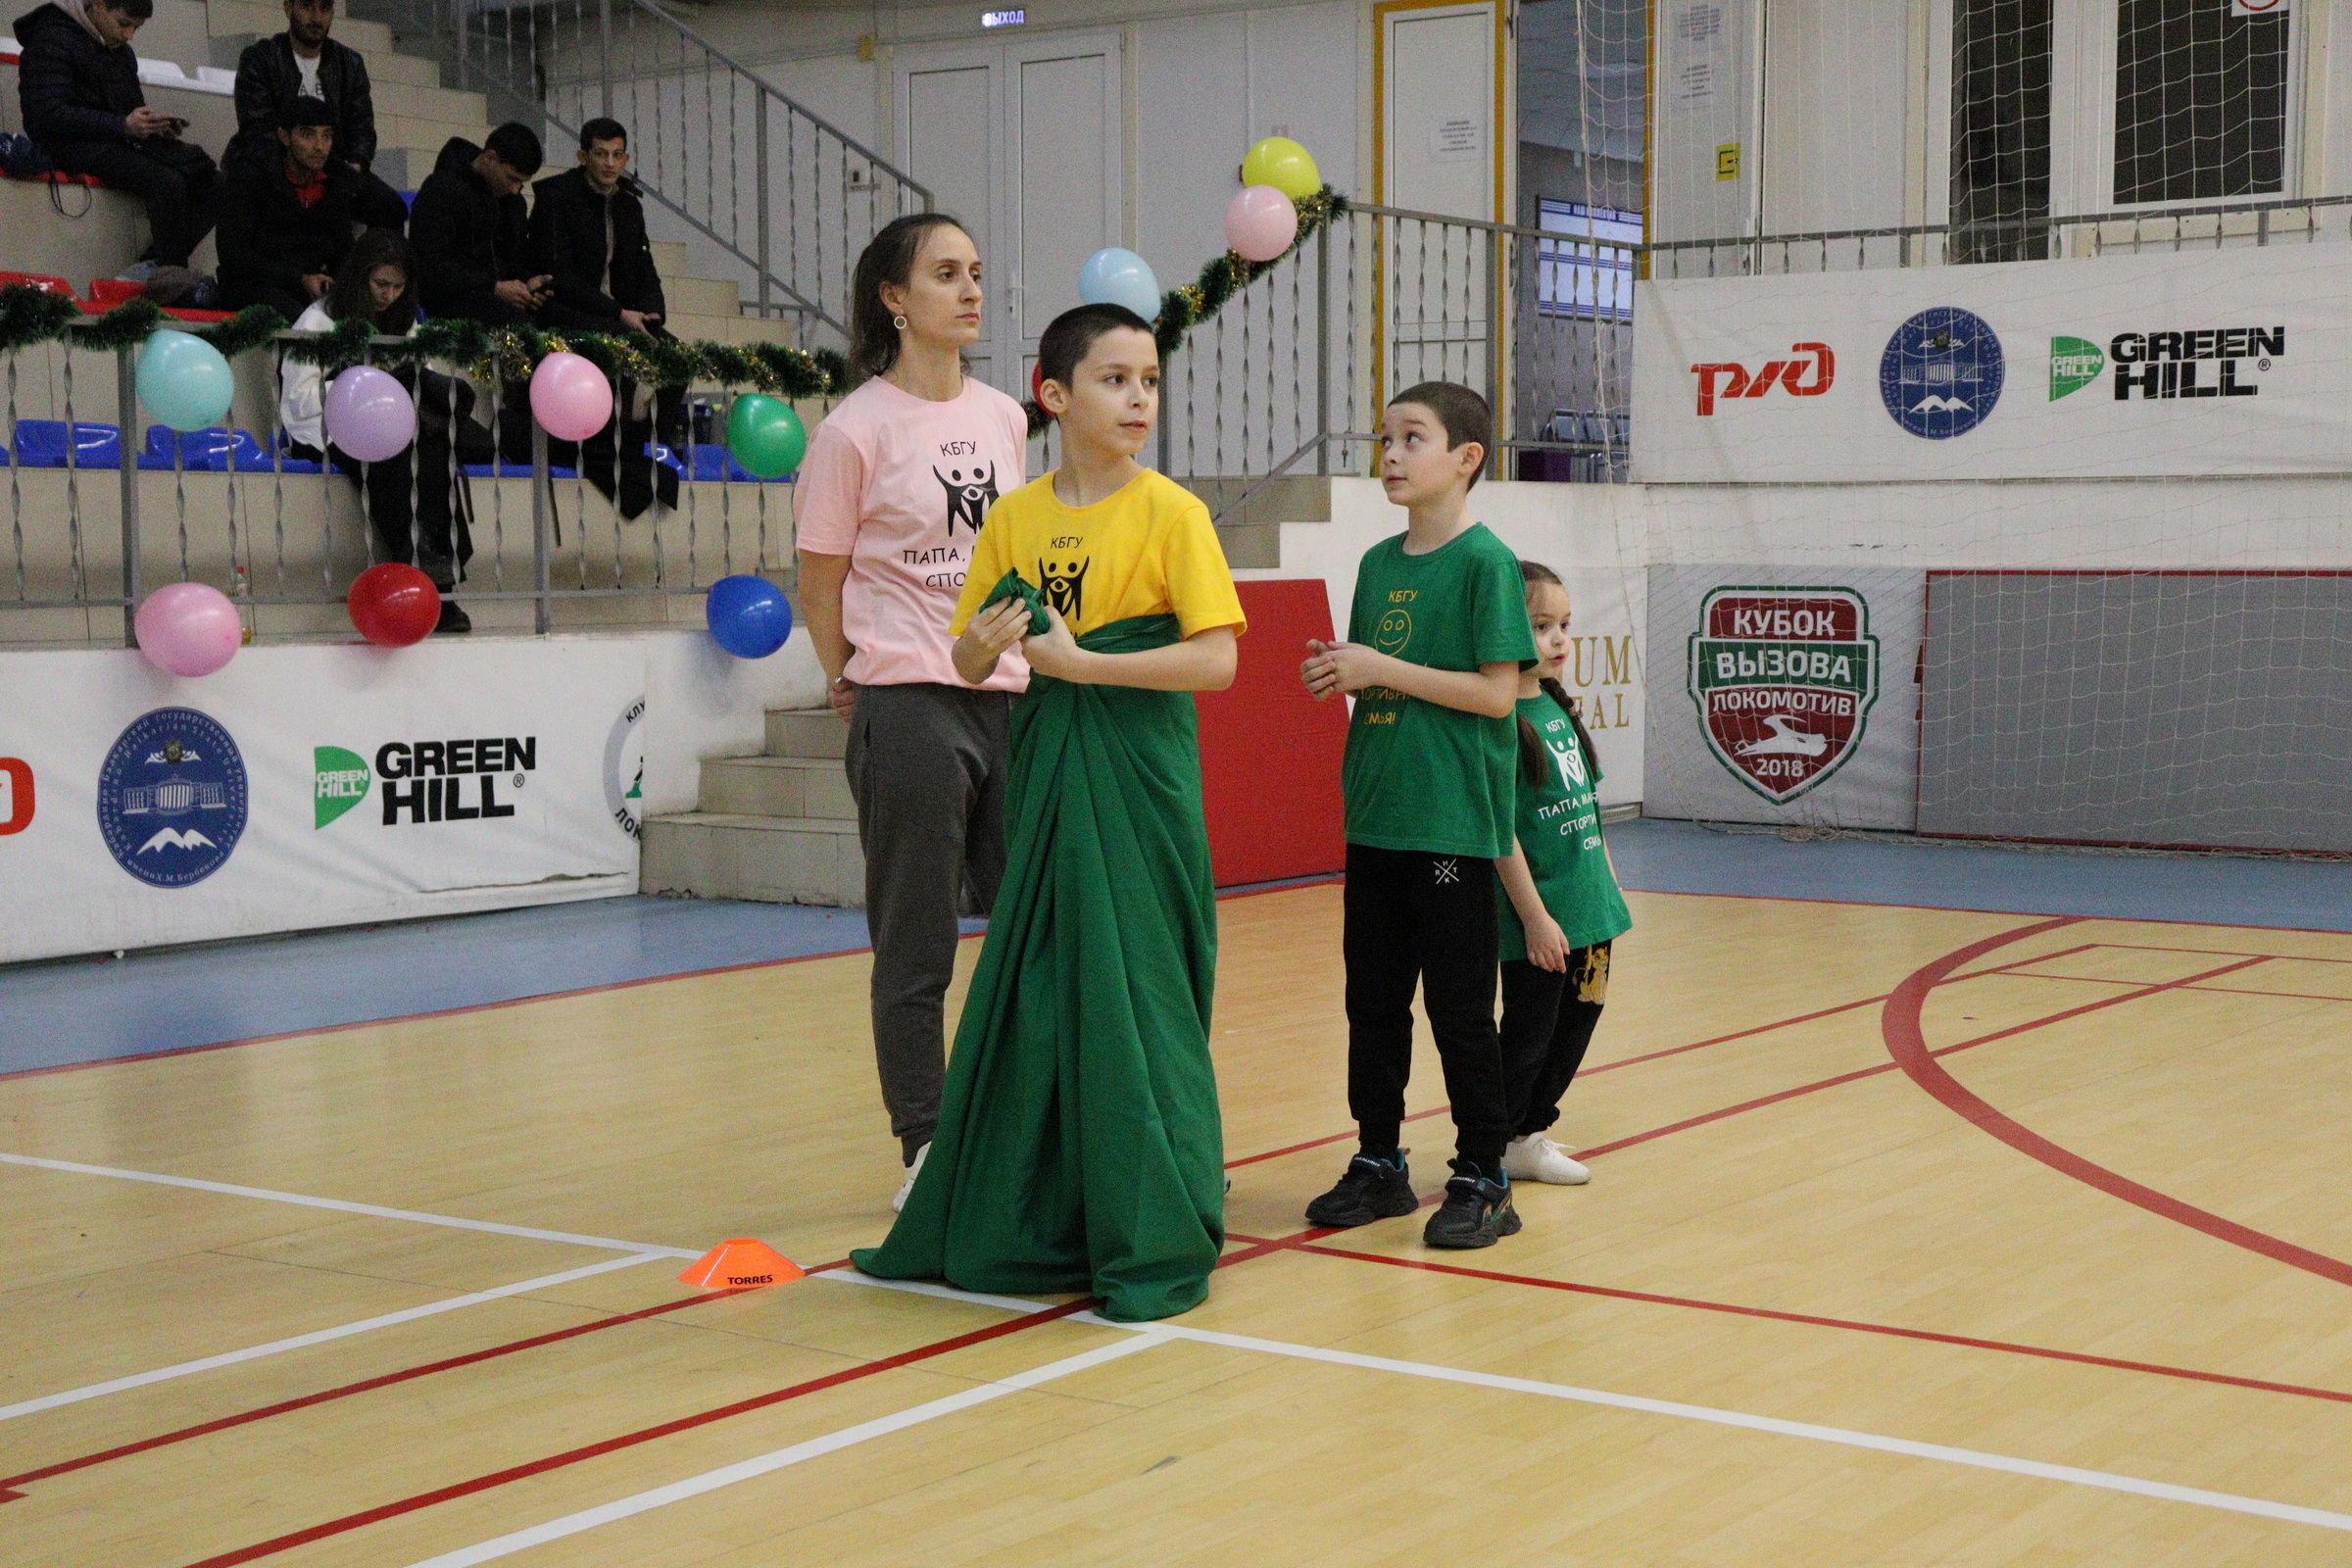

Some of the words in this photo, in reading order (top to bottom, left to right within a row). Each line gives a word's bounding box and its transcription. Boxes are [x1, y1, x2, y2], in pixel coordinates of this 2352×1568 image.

[982, 10, 1025, 27] ВЫХОД
[2111, 326, 2285, 363] GREEN
[2051, 354, 2103, 366] GREEN
[2053, 364, 2094, 377] HILL
[2115, 360, 2258, 400] HILL
[940, 441, 976, 457] КБГУ
[1051, 536, 1084, 549] КБГУ
[903, 548, 966, 564] ПАПА,
[1388, 590, 1418, 603] КБГУ
[1733, 609, 1836, 637] КУБОК
[1715, 650, 1852, 683] ВЫЗОВА
[1713, 690, 1852, 716] ЛОКОМОТИВ
[1545, 717, 1566, 733] КБГУ
[375, 737, 536, 779] GREEN
[317, 769, 368, 784] GREEN
[1755, 759, 1804, 777] 2018
[318, 782, 363, 799] HILL
[382, 775, 515, 825] HILL
[1538, 798, 1582, 819] ПАПА,
[727, 1274, 773, 1285] TORRES
